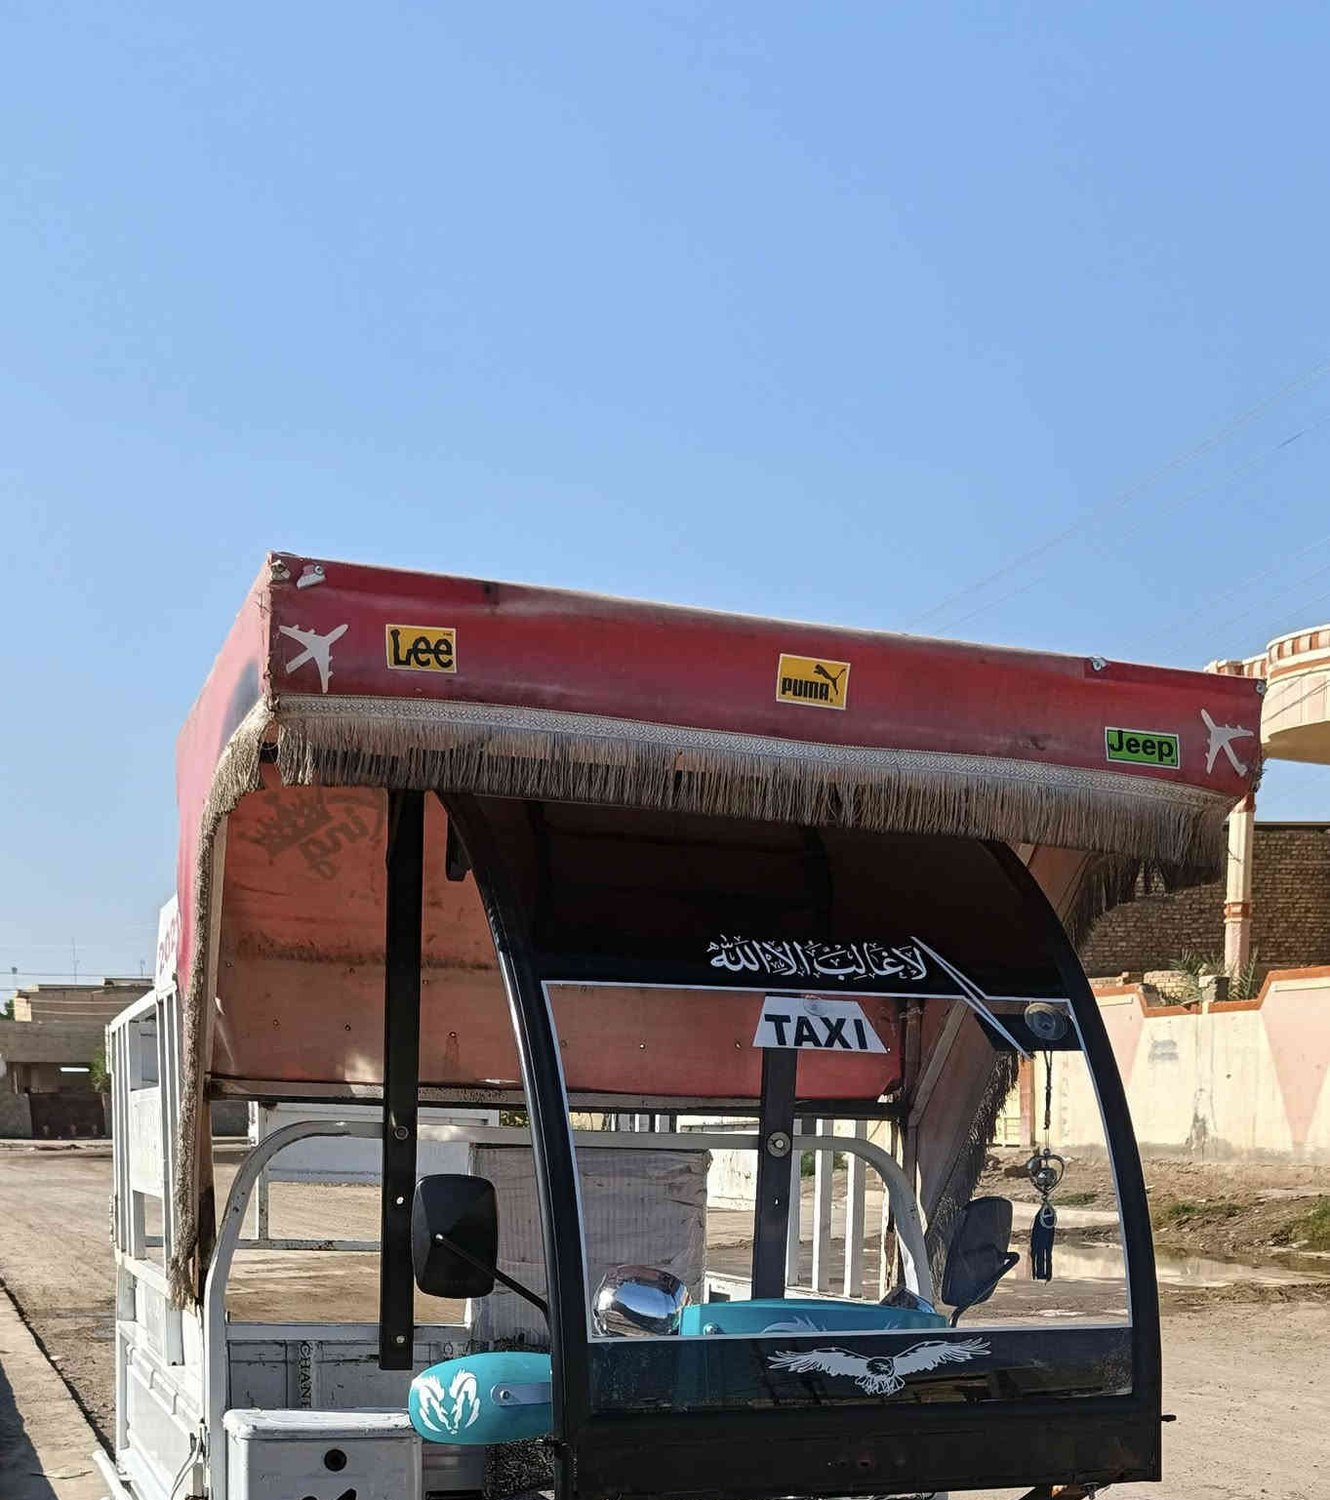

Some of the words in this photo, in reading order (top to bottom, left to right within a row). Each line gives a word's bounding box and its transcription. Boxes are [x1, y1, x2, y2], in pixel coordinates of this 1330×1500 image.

[390, 629, 453, 668] Lee
[781, 677, 830, 701] PUMA
[1108, 730, 1174, 762] Jeep
[764, 1014, 868, 1049] TAXI
